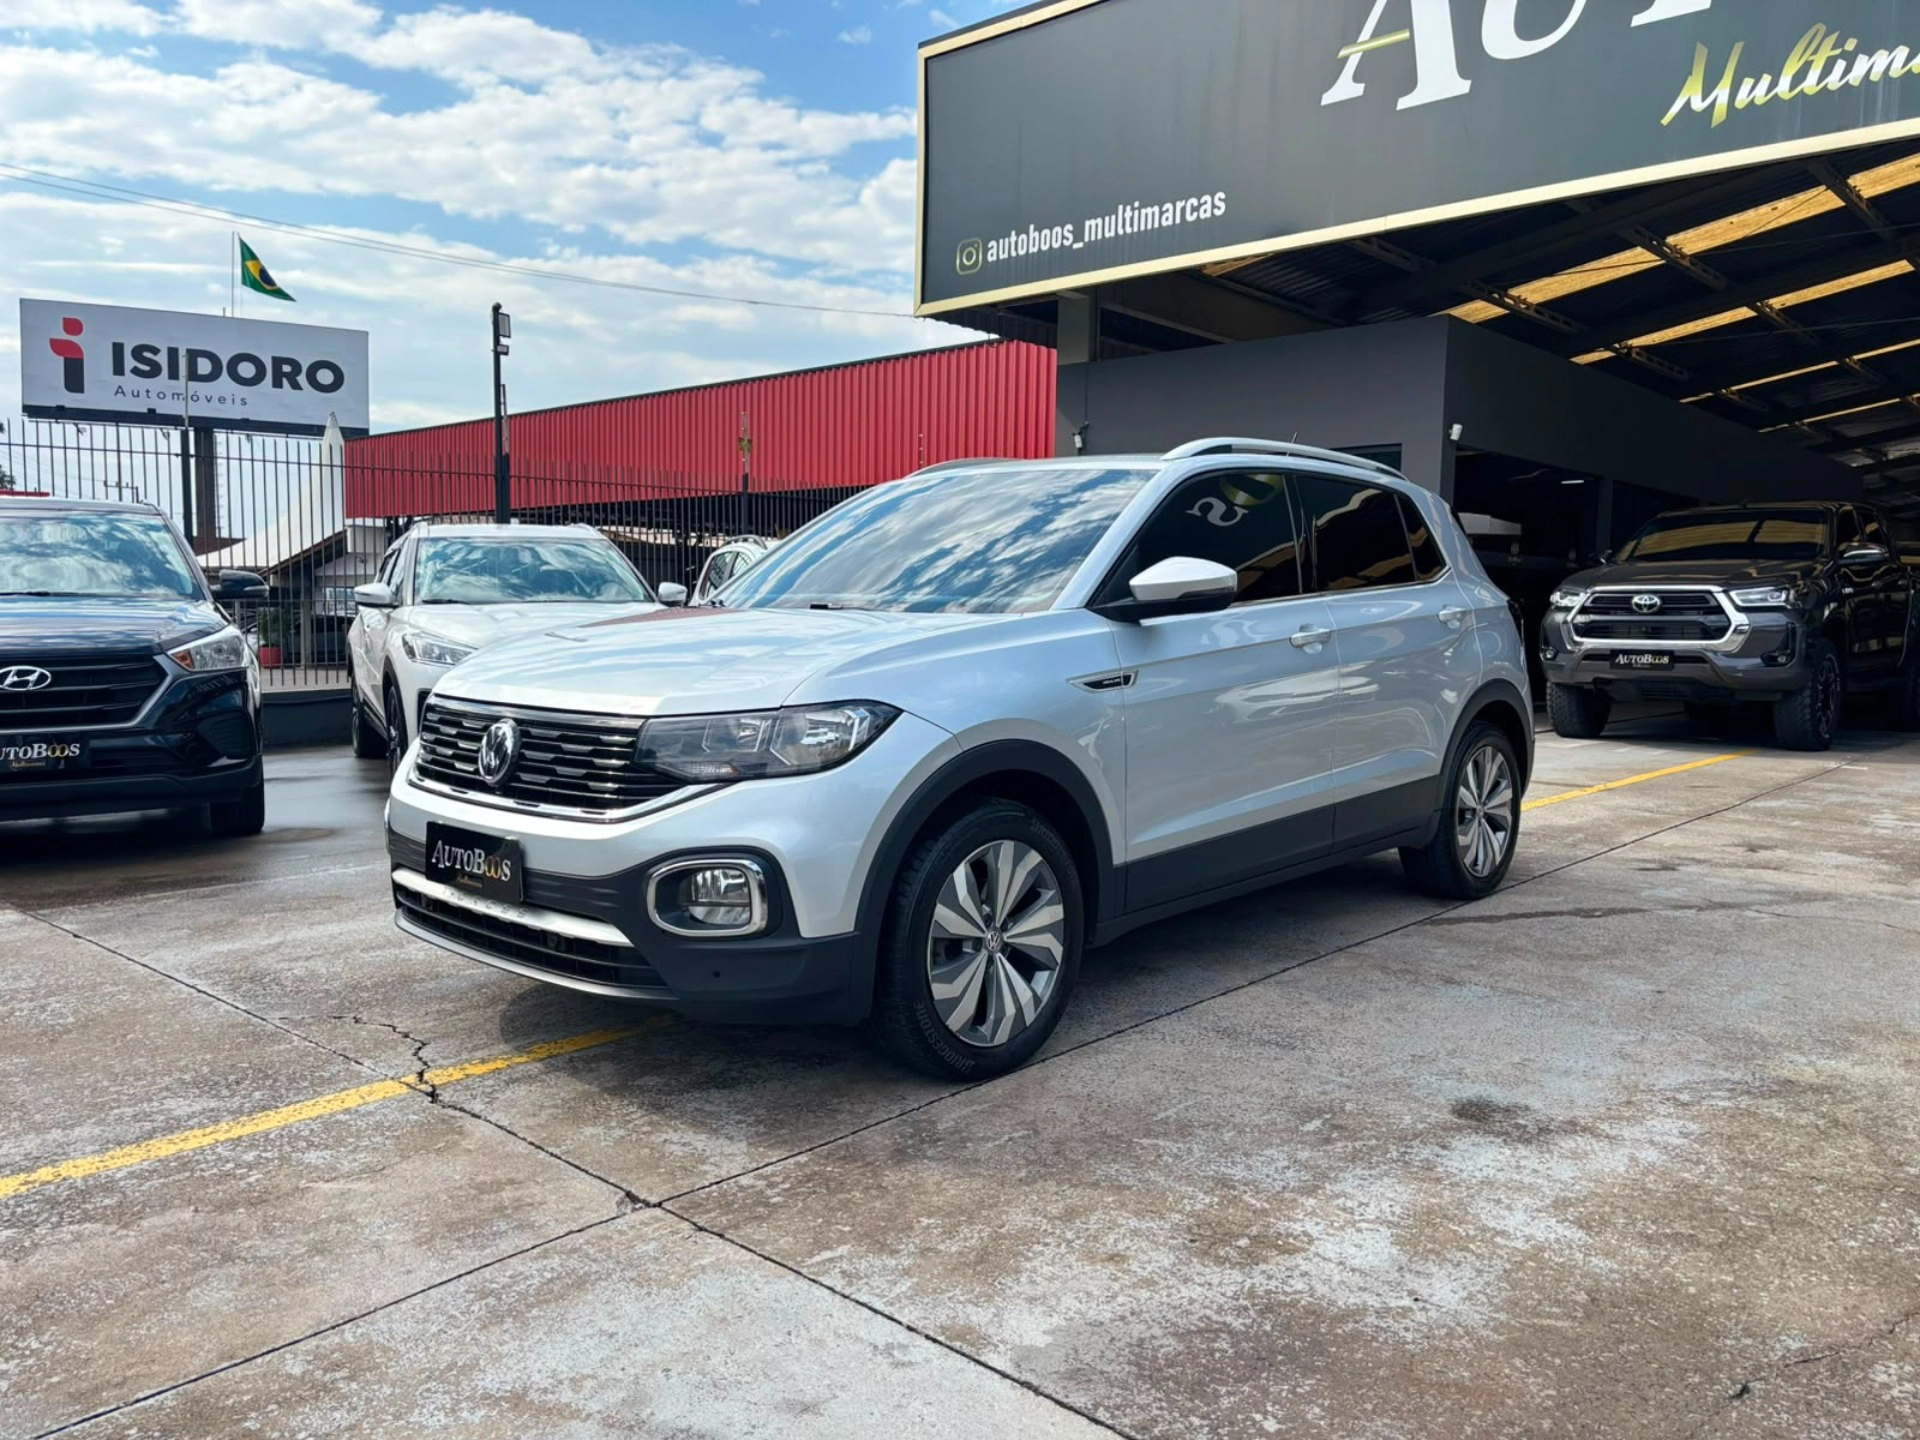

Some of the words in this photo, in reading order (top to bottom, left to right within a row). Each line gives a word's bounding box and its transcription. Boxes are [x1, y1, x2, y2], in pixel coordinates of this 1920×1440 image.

[1660, 22, 1920, 128] Multim
[987, 191, 1226, 262] autoboos_multimarcas
[112, 341, 345, 393] ISIDORO
[114, 385, 248, 406] Automóveis
